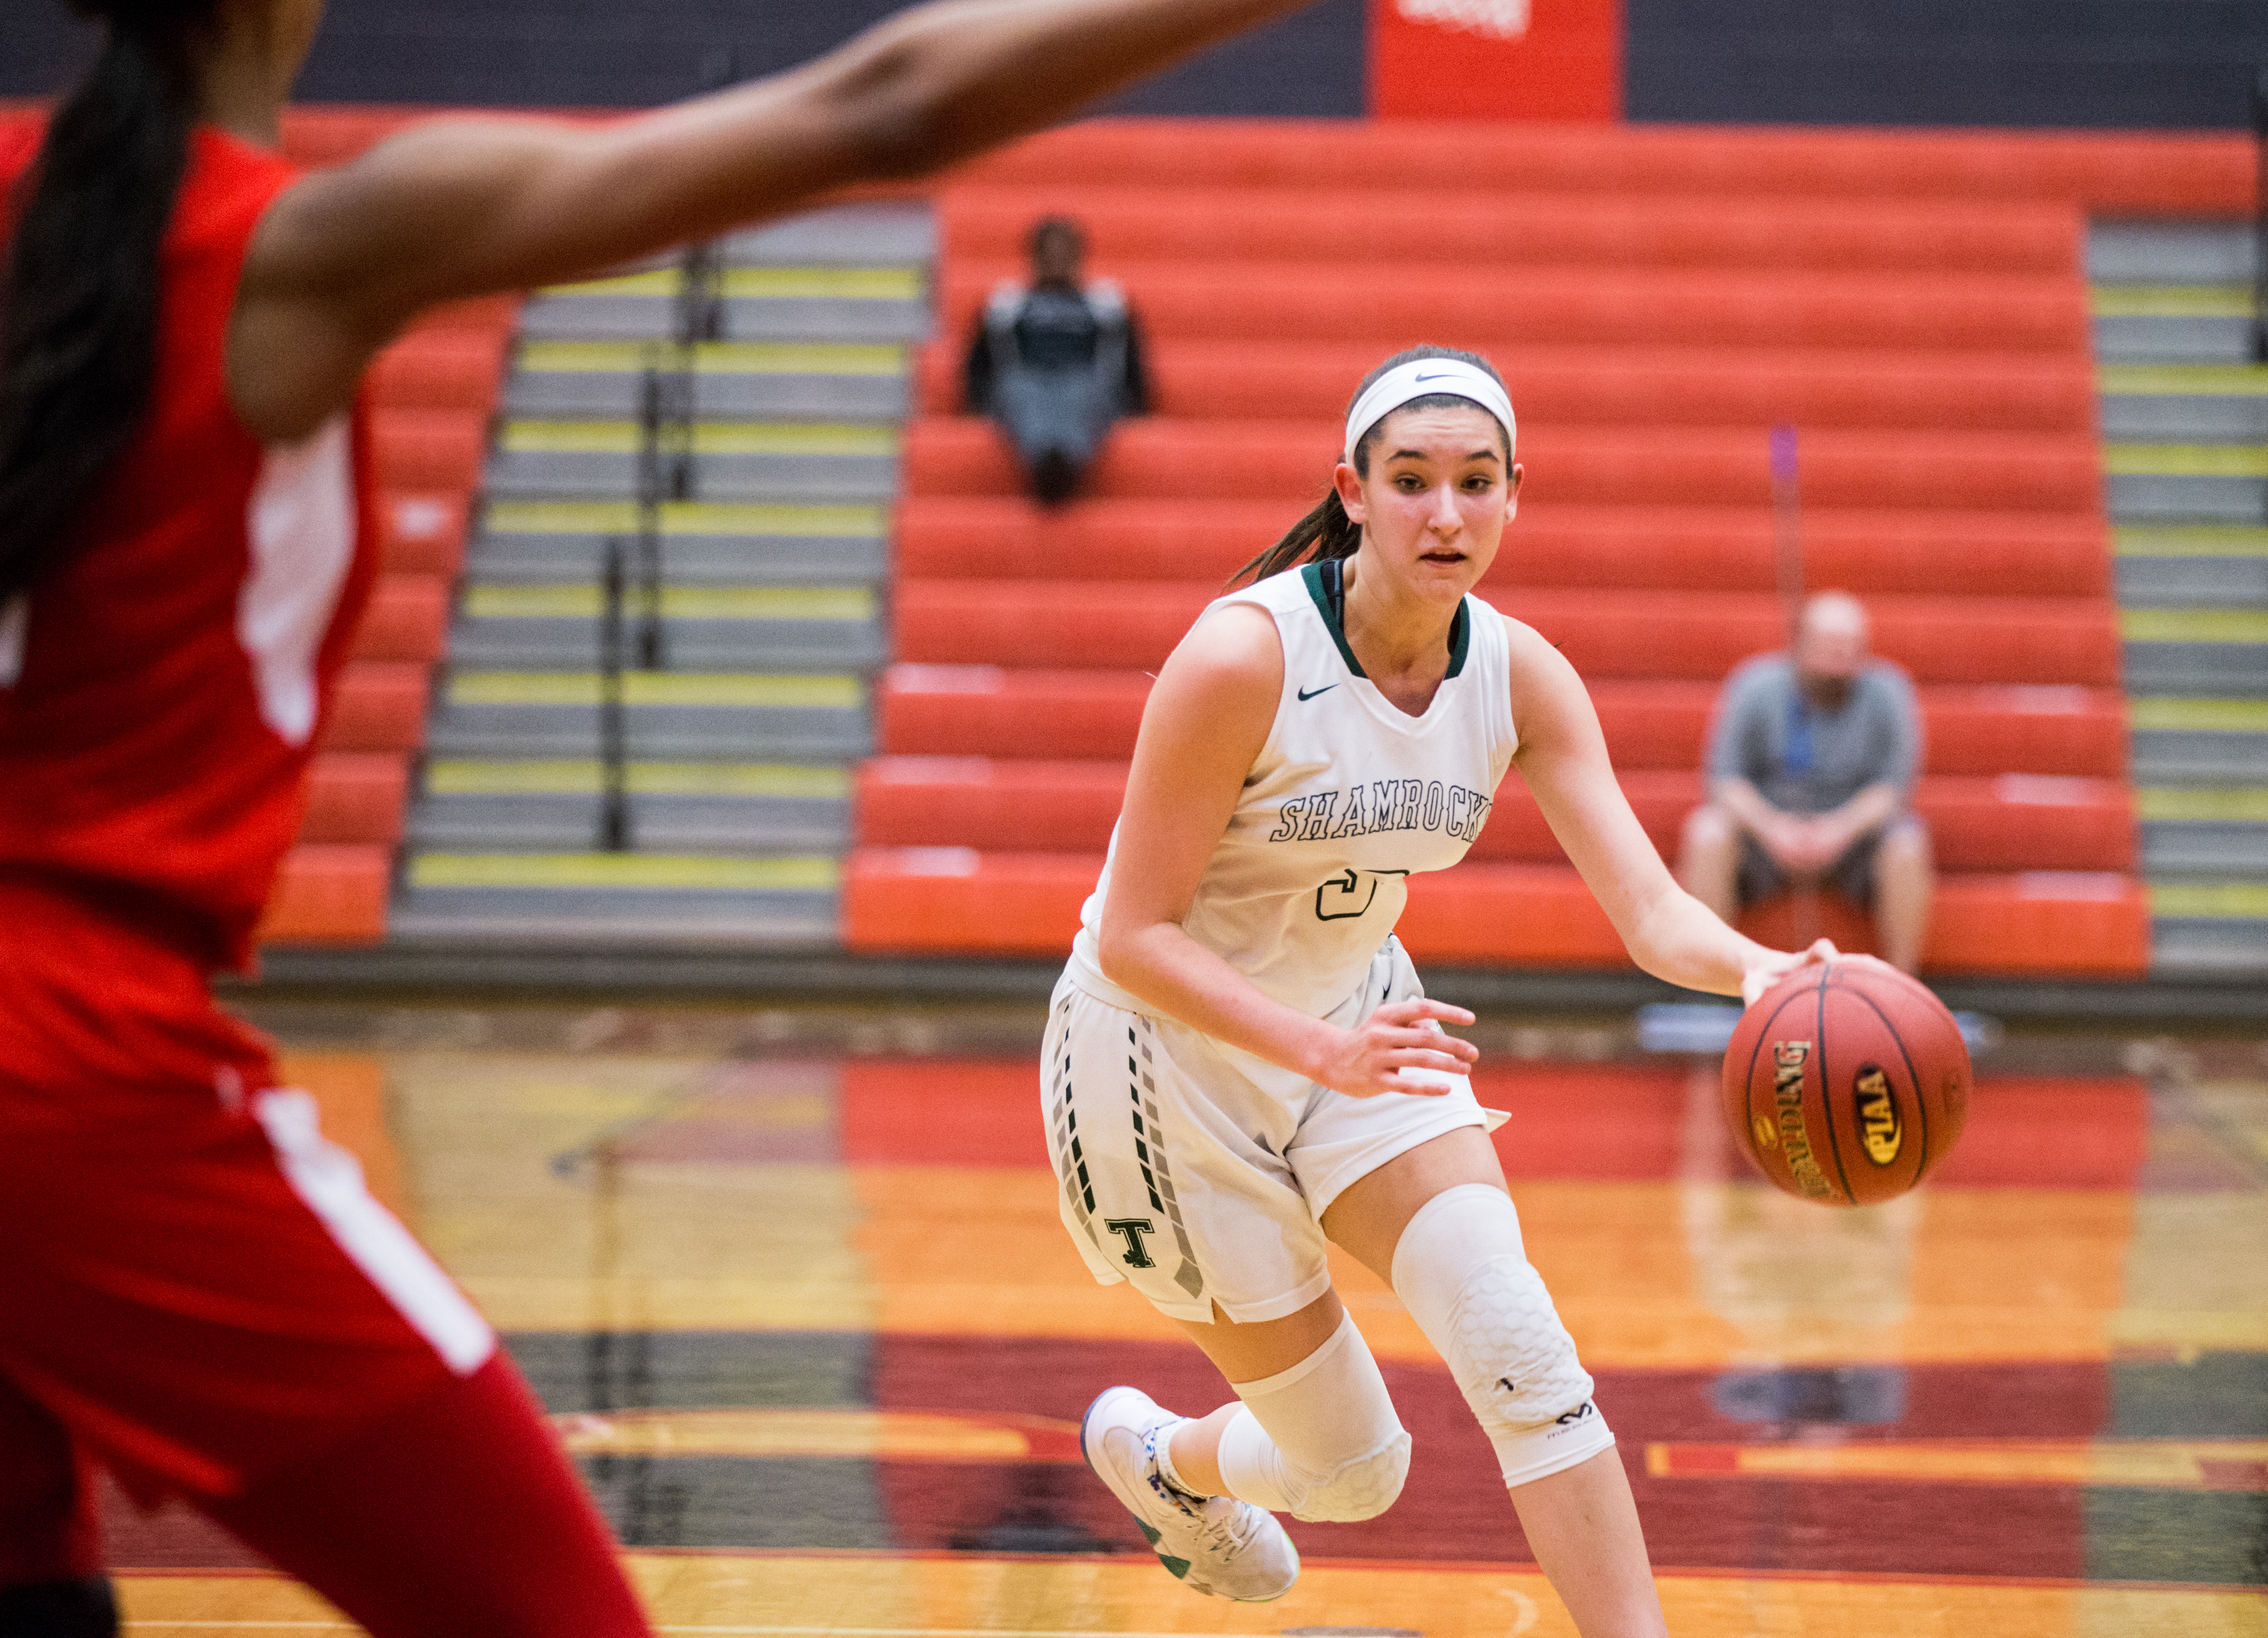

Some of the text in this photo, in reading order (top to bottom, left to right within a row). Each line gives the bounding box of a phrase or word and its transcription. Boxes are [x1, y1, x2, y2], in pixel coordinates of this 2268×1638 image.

[1269, 779, 1492, 843] SHAMROCK
[1858, 1070, 1900, 1164] PIAA
[1104, 1218, 1157, 1268] T
